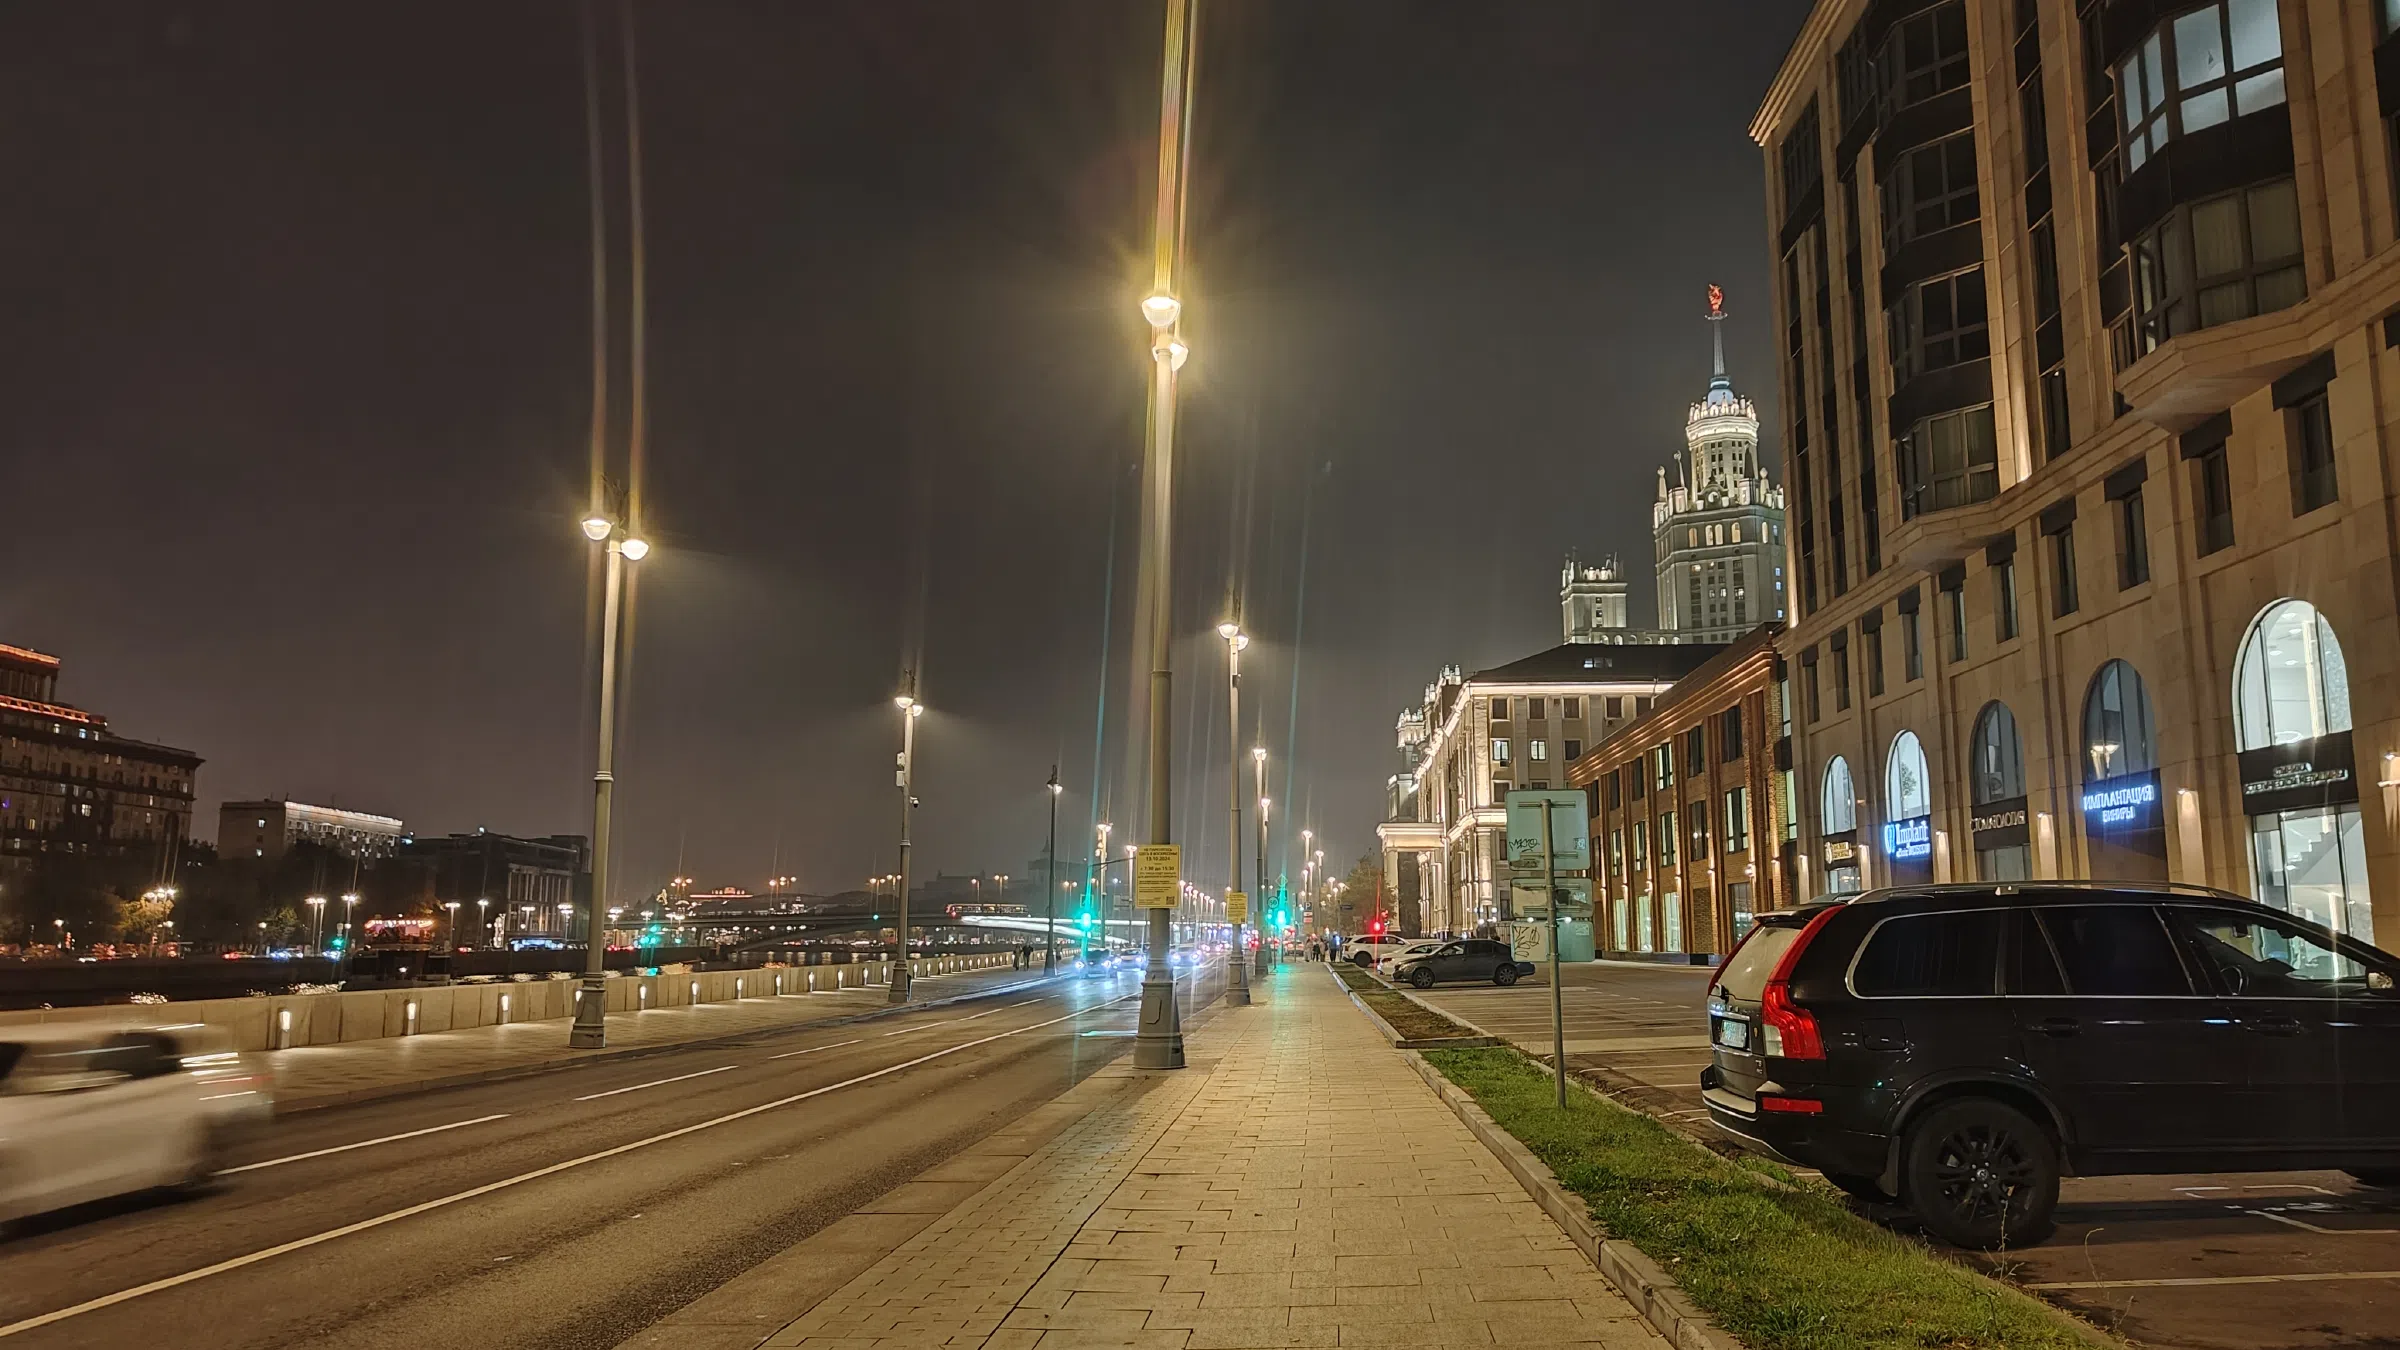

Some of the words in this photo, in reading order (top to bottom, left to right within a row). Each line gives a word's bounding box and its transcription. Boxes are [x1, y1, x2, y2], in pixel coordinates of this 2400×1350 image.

[2083, 785, 2154, 811] ИМПЛАНТАЦИЯ
[1895, 820, 1929, 846] Implant
[1970, 811, 2026, 832] СТОМАТОЛОГИЯ
